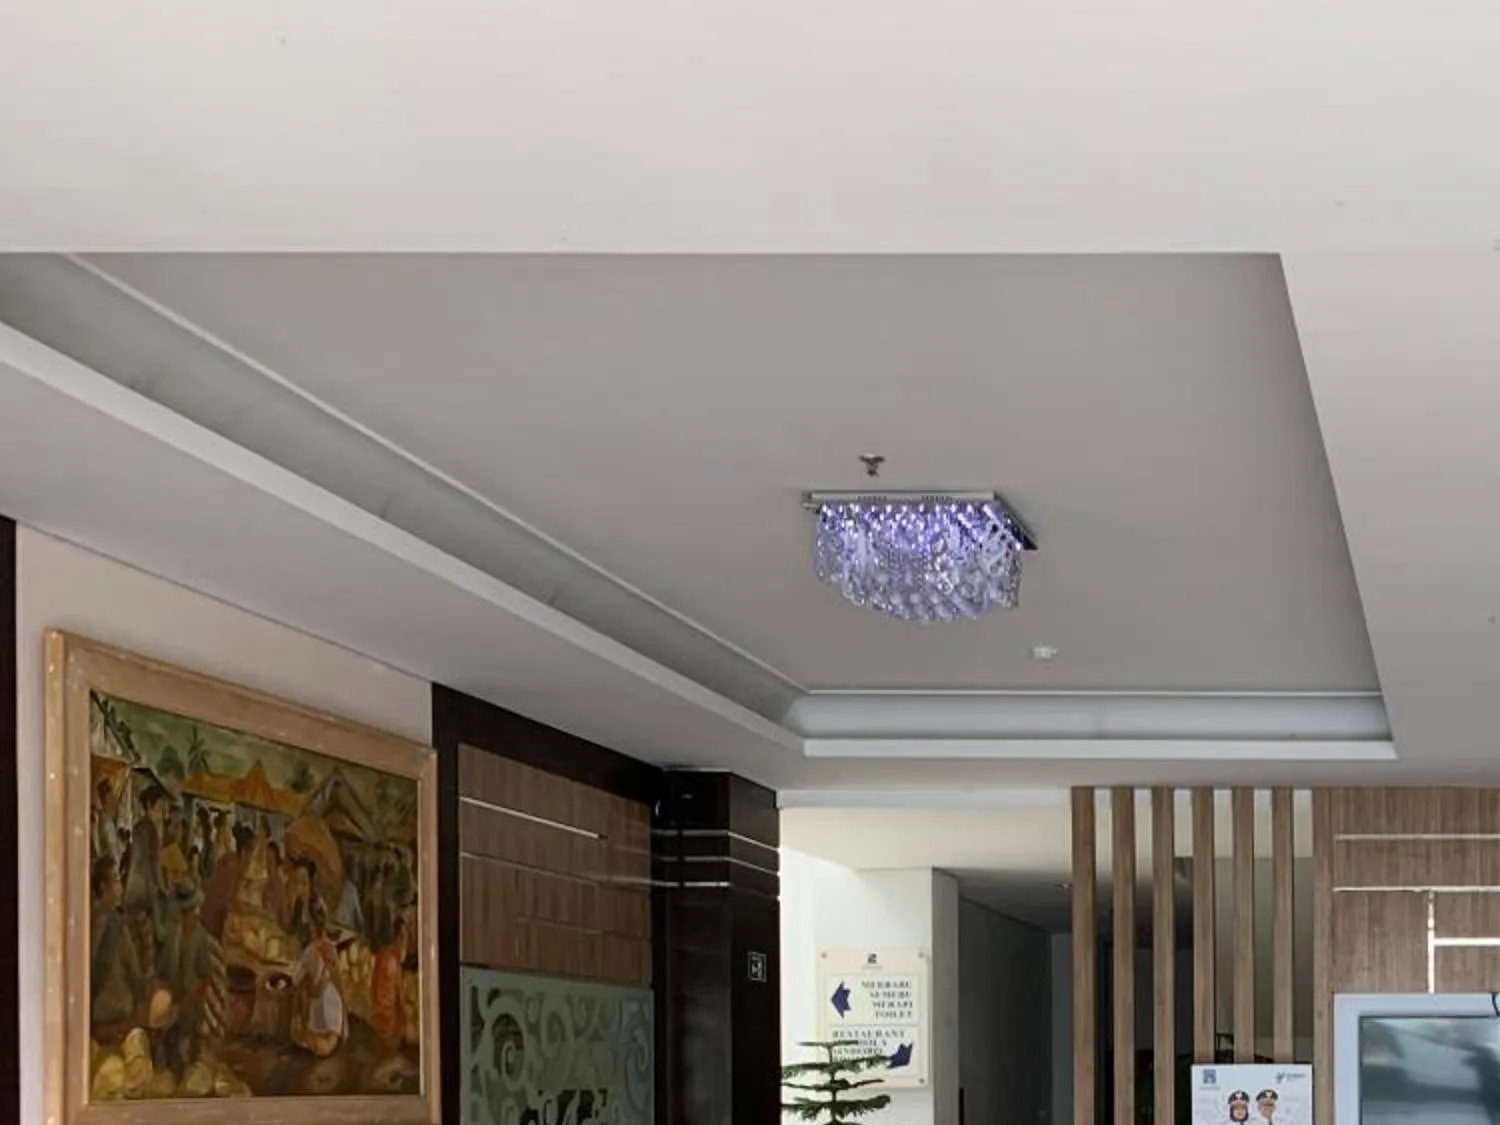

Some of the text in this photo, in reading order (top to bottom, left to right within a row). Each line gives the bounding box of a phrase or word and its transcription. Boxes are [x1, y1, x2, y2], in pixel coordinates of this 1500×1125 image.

[872, 1001, 913, 1009] MERAPI
[875, 1011, 912, 1019] TOILET
[832, 1030, 905, 1038] RESTAURANT
